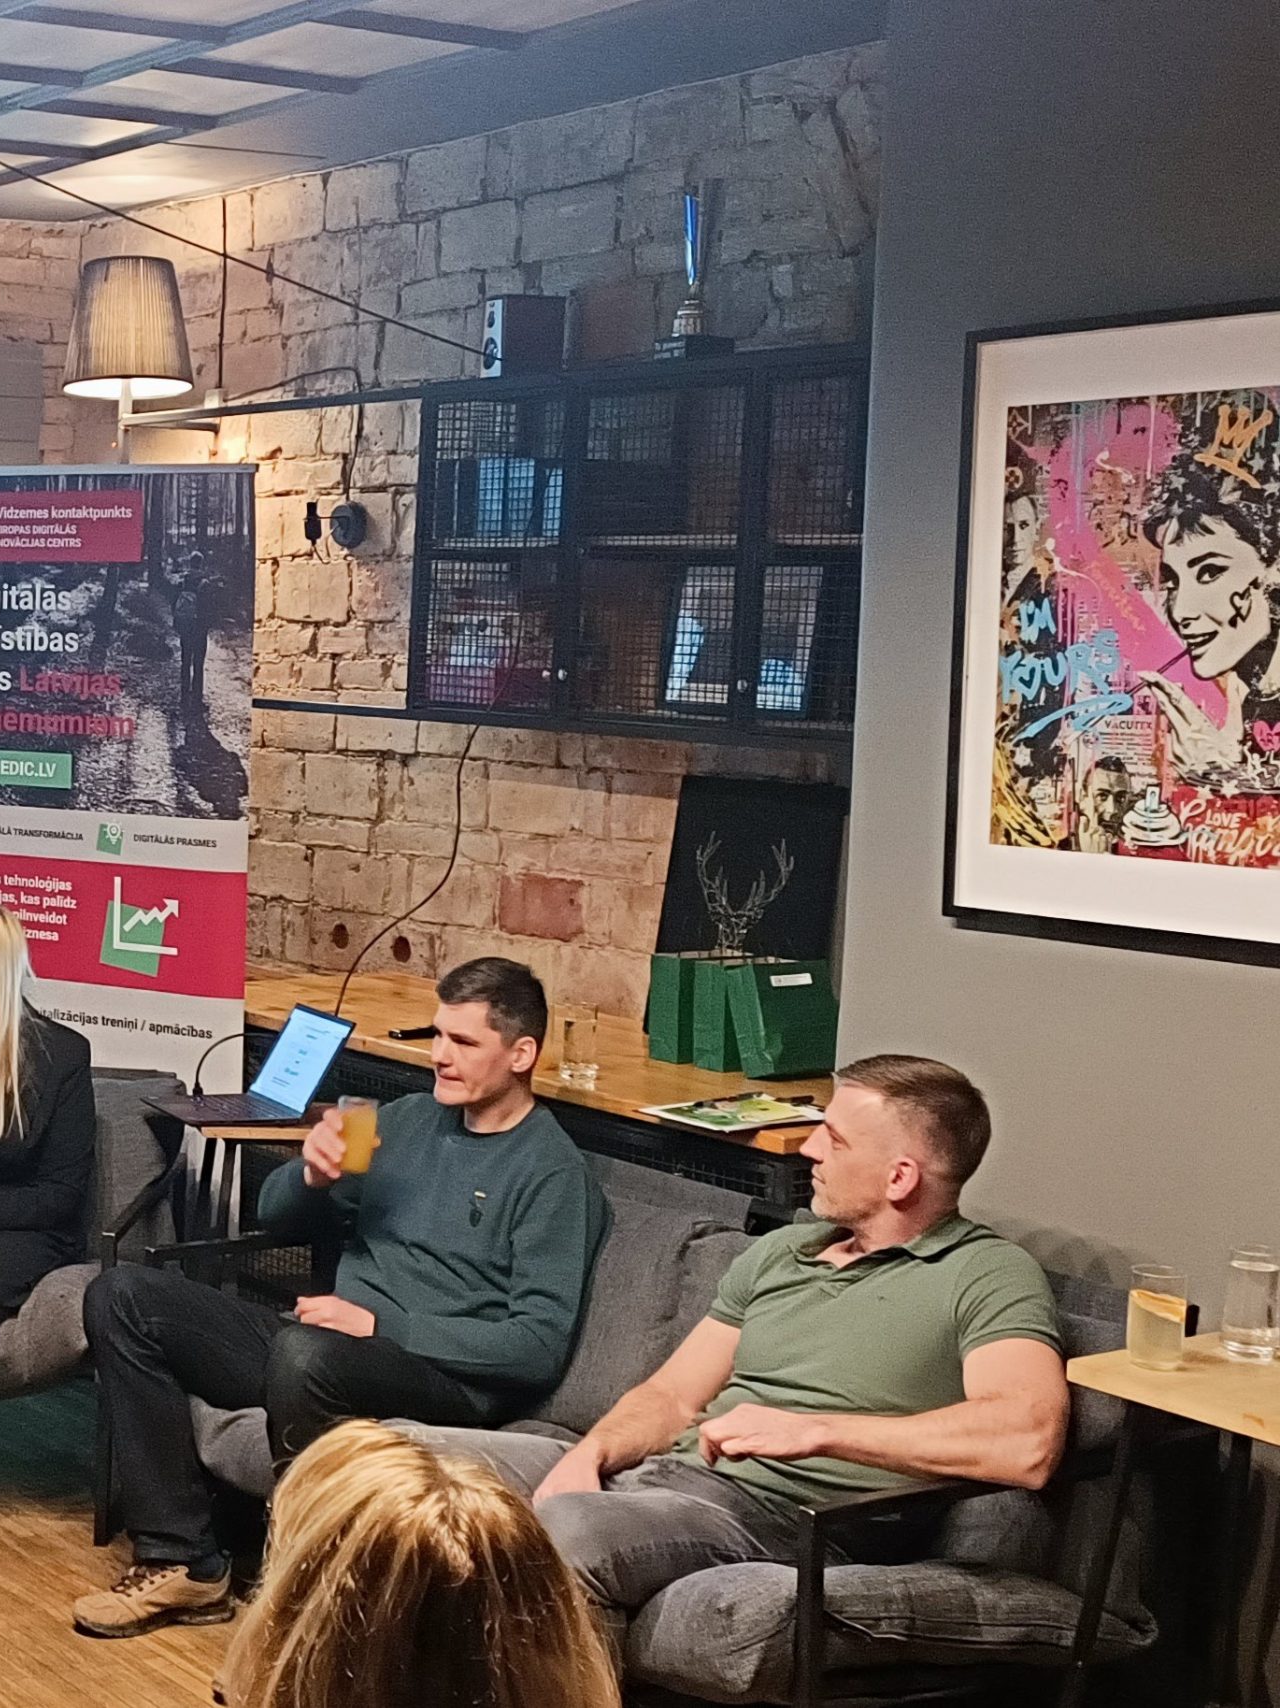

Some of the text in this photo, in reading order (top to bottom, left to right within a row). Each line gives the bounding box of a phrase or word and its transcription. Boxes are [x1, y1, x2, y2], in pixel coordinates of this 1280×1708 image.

[51, 505, 133, 521] kontaktpunkts
[46, 538, 82, 548] CENTRS
[1204, 808, 1248, 828] LOVE
[14, 828, 84, 841] TRANSFORMĀCIJA
[133, 833, 217, 848] DIGITĀLĀS PRASMES
[3, 873, 73, 893] tehnoloģijas
[20, 891, 40, 905] kas
[43, 895, 77, 909] palīdz
[101, 1015, 138, 1034] treniņi
[148, 1021, 213, 1040] apmācības
